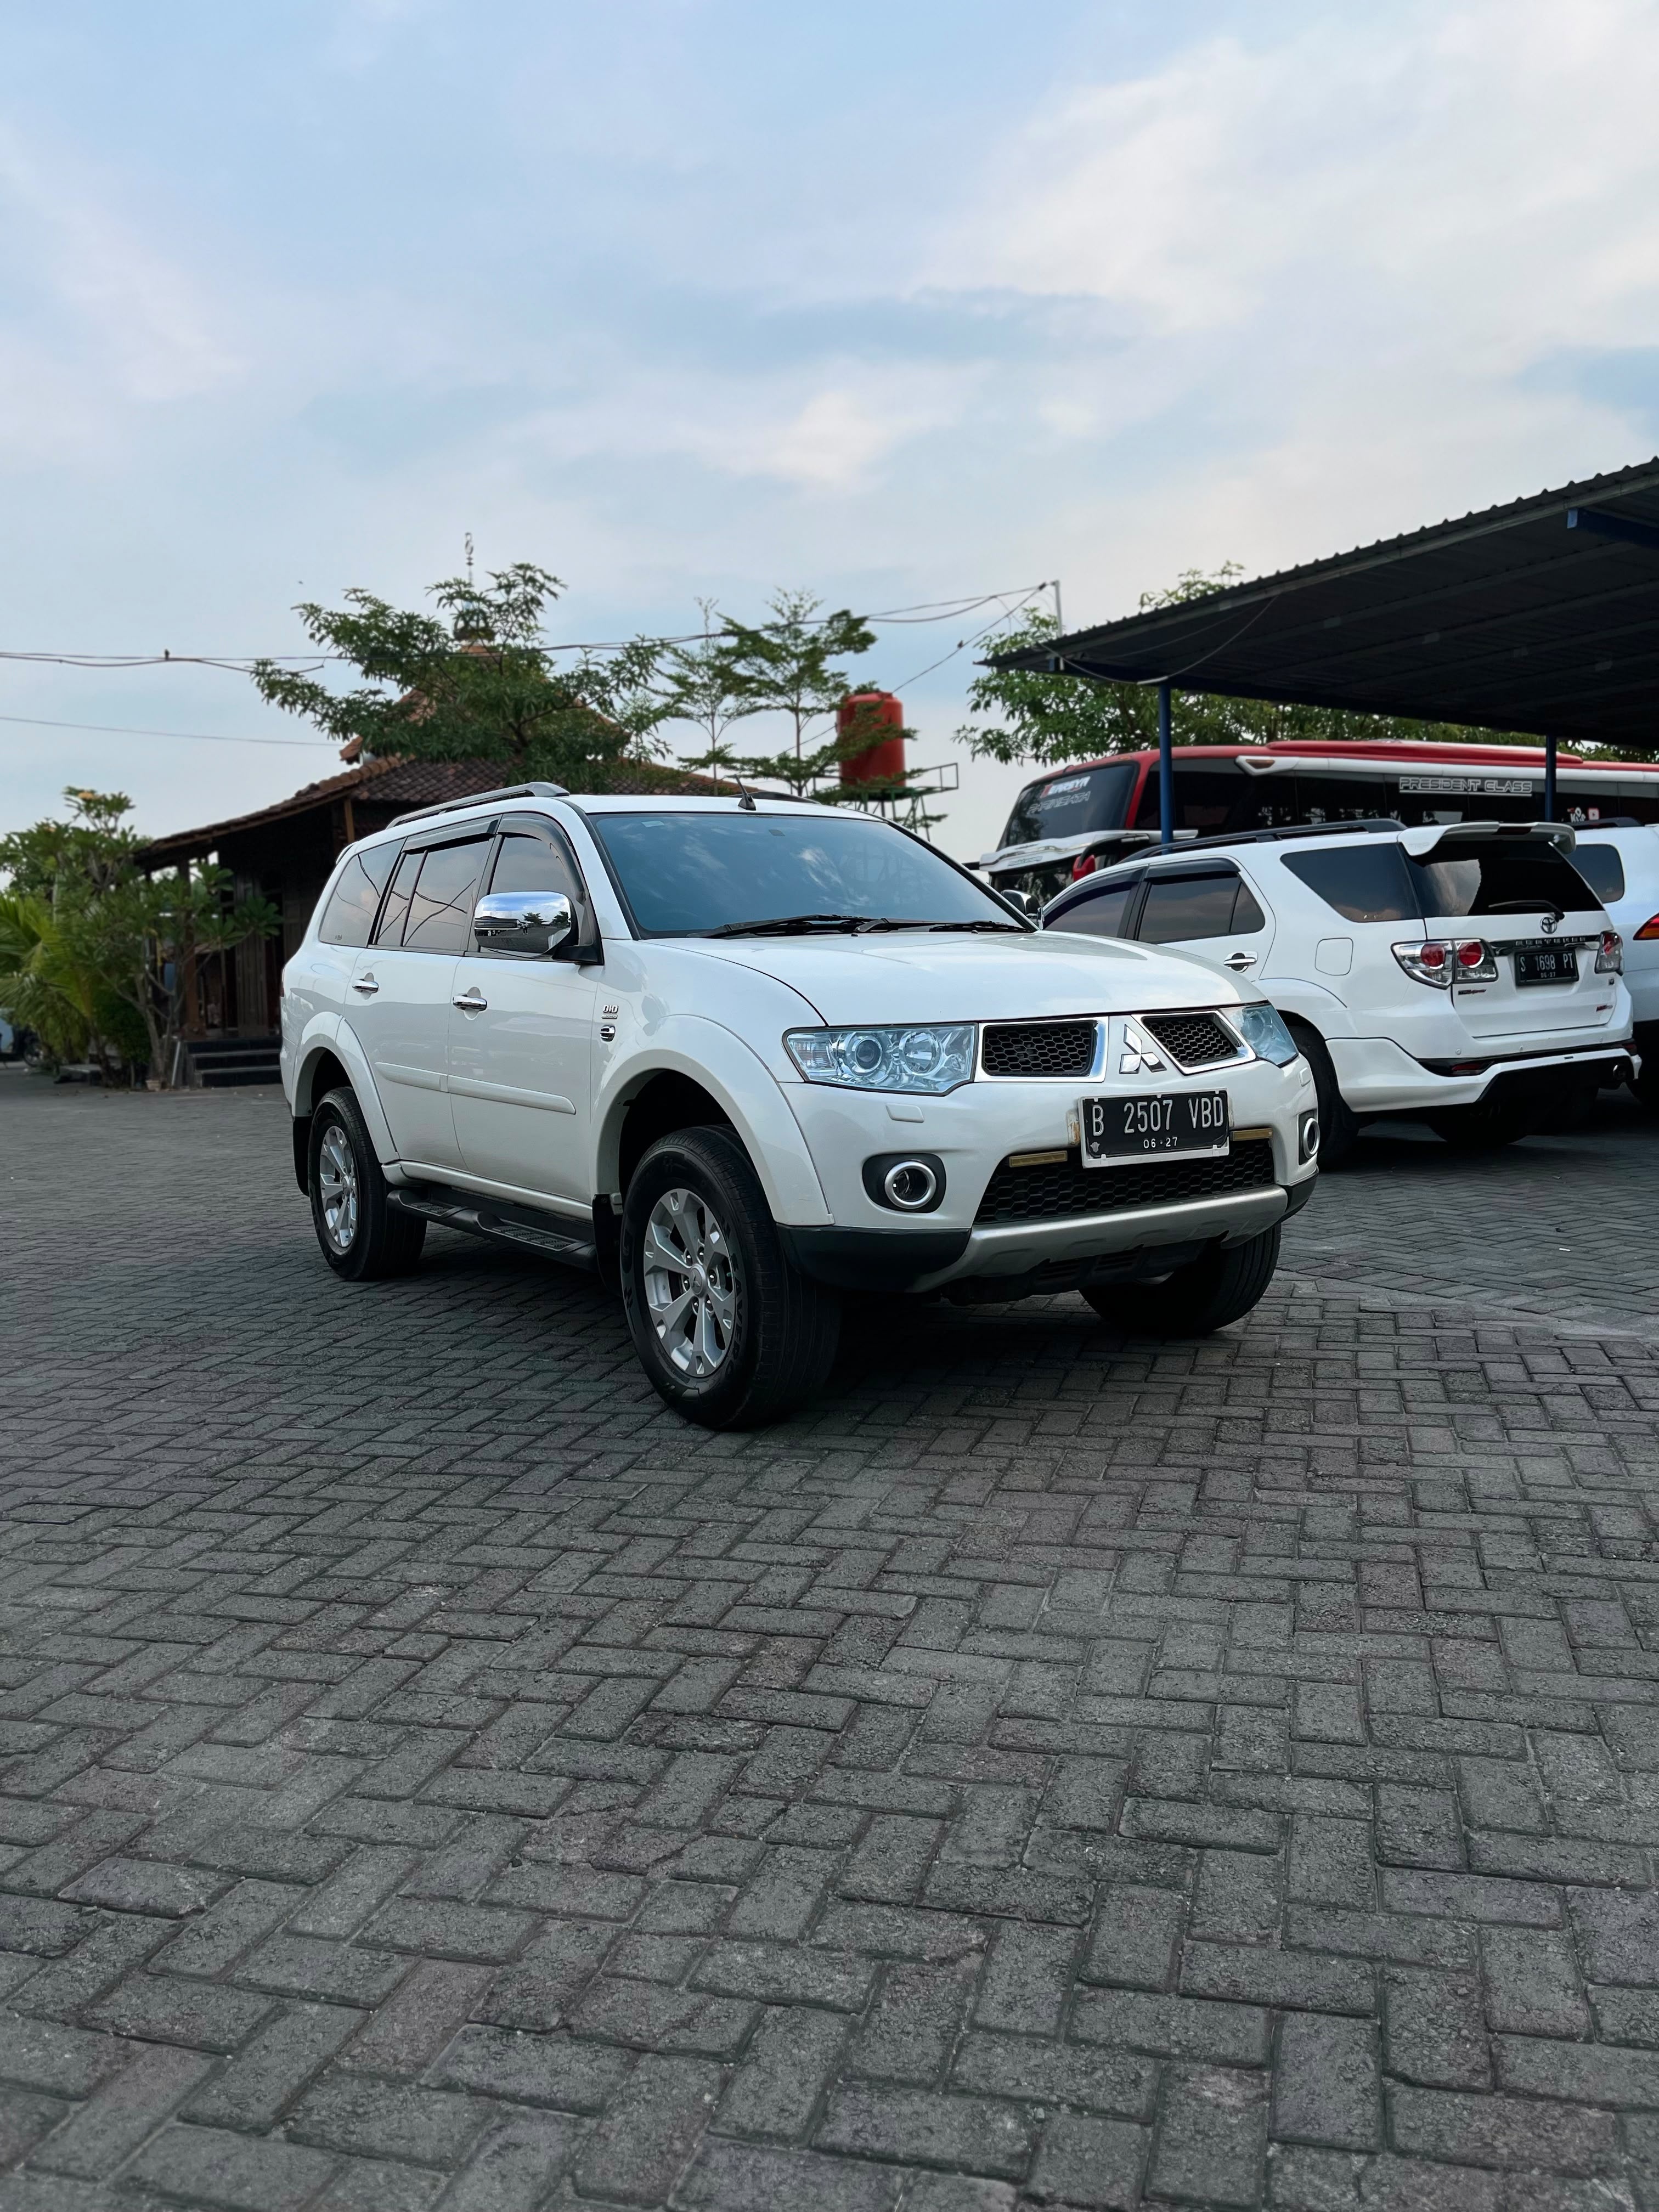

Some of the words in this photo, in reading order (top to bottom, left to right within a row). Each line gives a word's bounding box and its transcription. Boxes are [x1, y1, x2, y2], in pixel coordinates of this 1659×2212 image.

[1399, 776, 1481, 791] PRESIDENT
[1485, 780, 1532, 793] CLASS
[1520, 956, 1526, 972] S
[1534, 954, 1556, 971] 1698
[1562, 953, 1573, 969] PT
[1092, 1104, 1104, 1136] B
[1124, 1099, 1173, 1134] 2507
[1188, 1097, 1223, 1128] VBD
